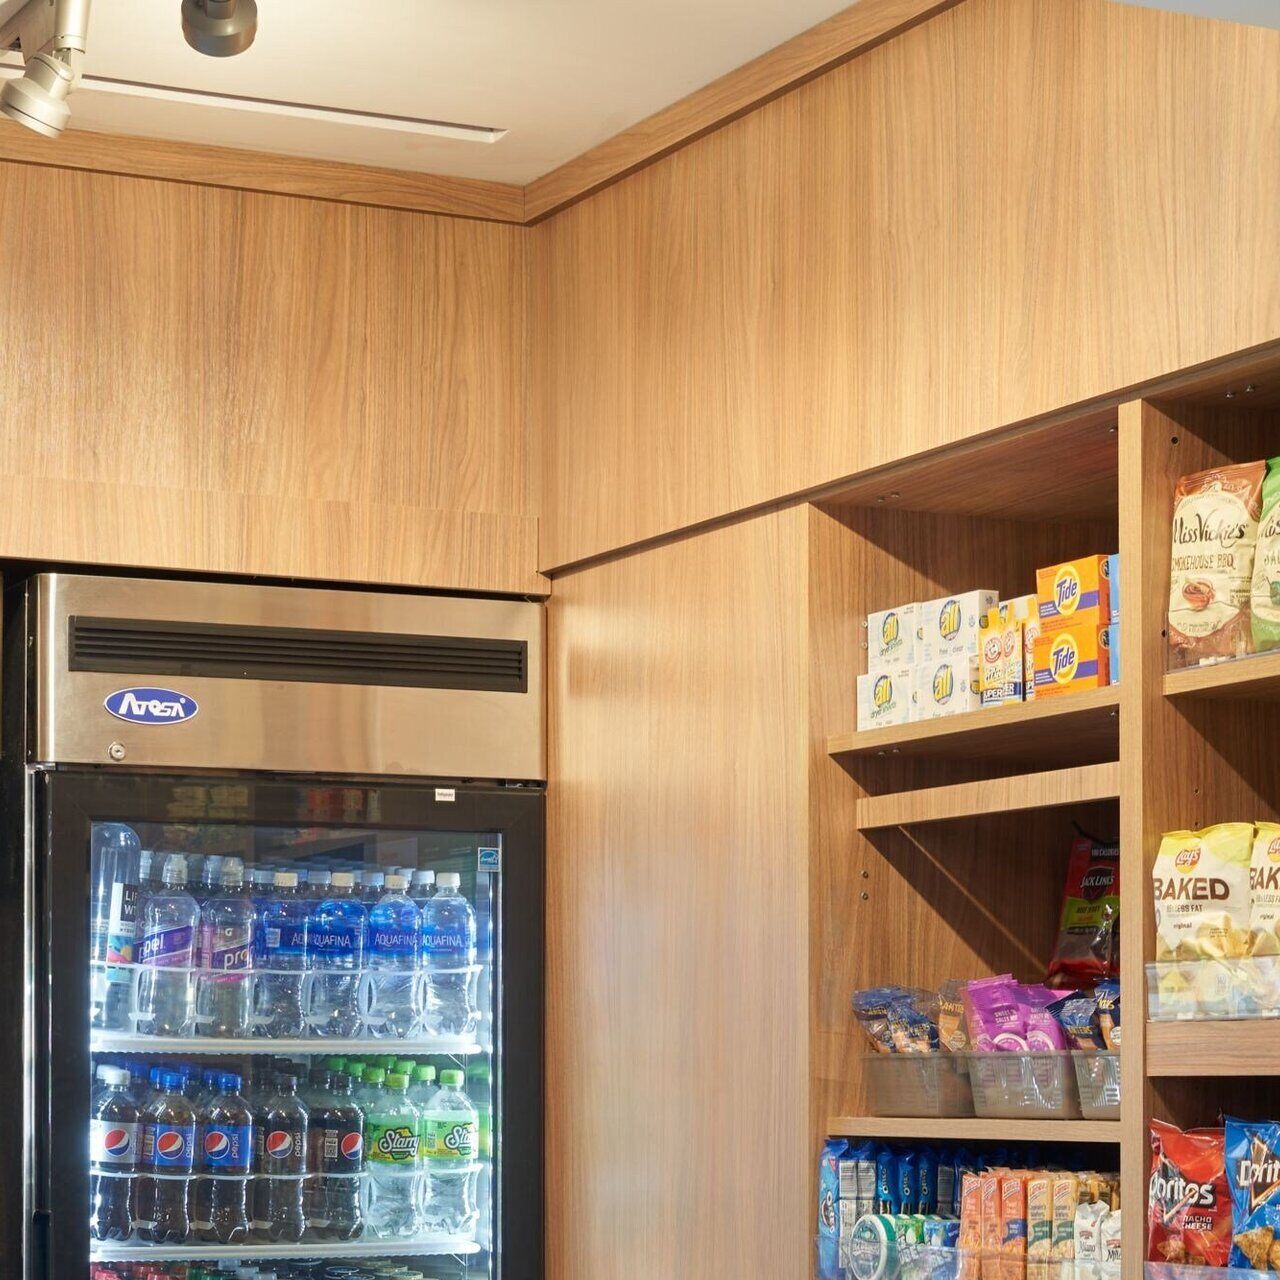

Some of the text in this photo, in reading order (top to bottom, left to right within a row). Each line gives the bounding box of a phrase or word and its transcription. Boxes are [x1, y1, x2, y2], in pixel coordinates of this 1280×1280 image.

[1217, 553, 1236, 569] BBQ
[1056, 577, 1078, 607] Tide
[883, 615, 899, 644] all
[940, 601, 959, 634] all
[1053, 645, 1076, 676] Tide
[874, 678, 892, 708] all
[933, 665, 953, 702] all
[1176, 848, 1200, 866] Lay's
[1154, 877, 1230, 901] BAKED
[1191, 904, 1202, 913] FAT
[375, 933, 418, 947] AQUAFINA
[379, 1130, 420, 1155] Starry
[1150, 1172, 1215, 1205] Doritos
[1182, 1214, 1212, 1223] NACHO
